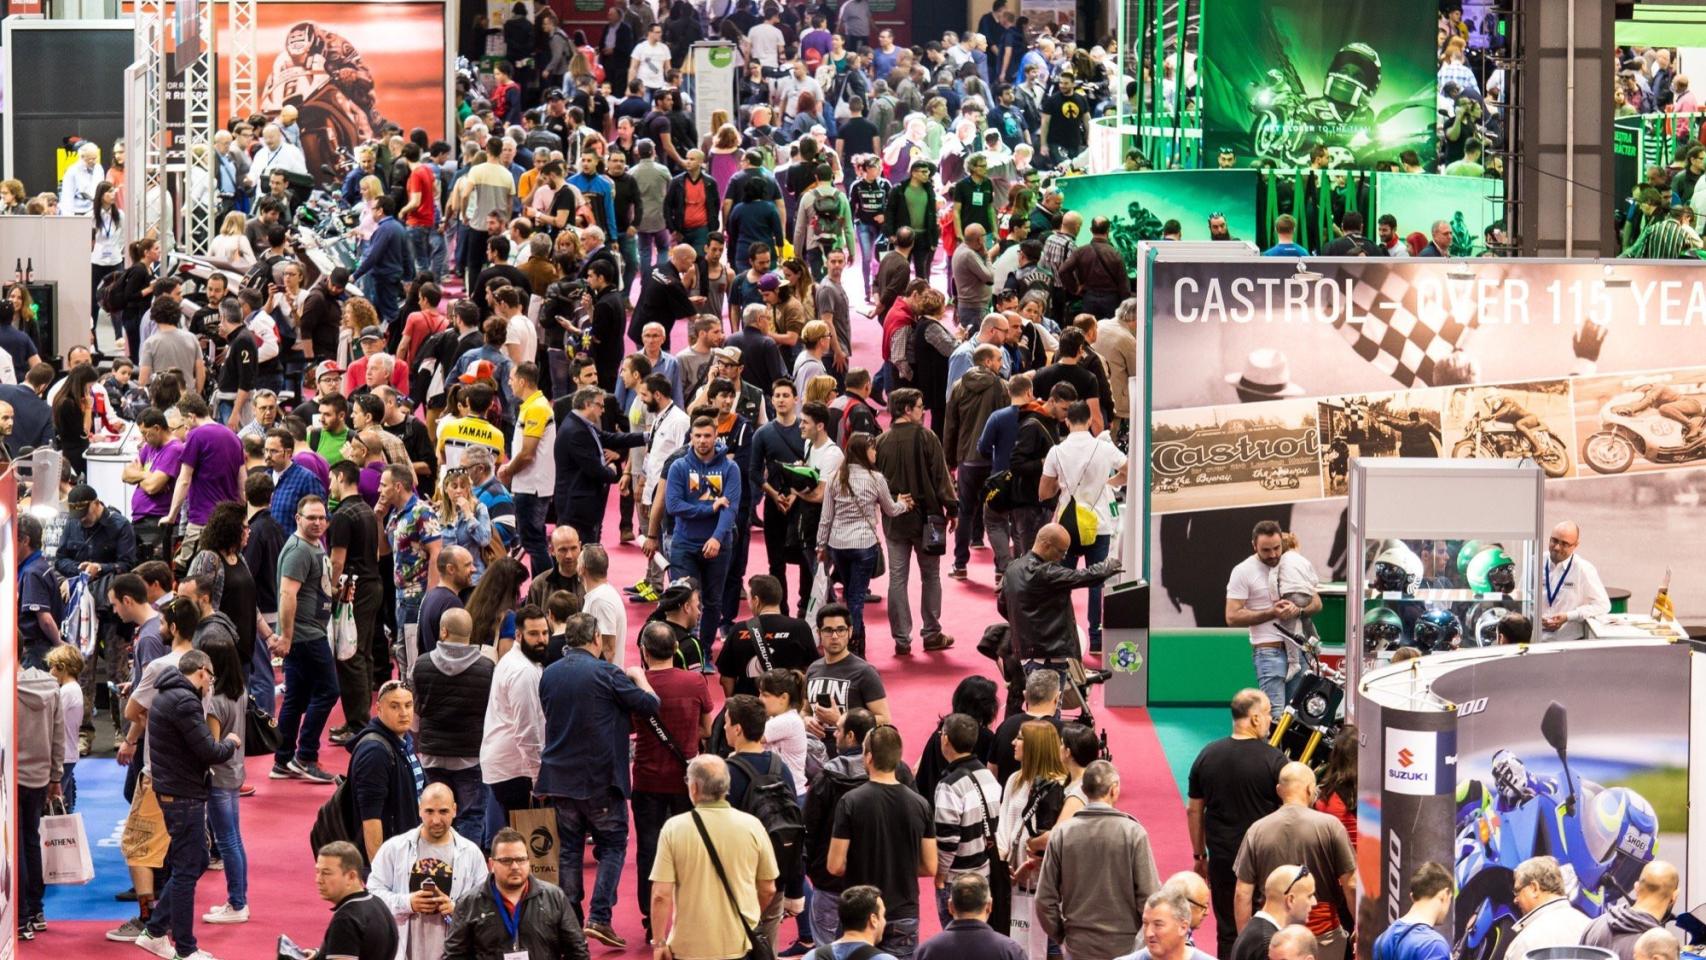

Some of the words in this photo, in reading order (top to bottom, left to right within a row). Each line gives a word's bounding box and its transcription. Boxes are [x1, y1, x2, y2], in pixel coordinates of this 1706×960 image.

[1174, 276, 1367, 323] CASTROL
[1416, 279, 1530, 325] OVER
[1546, 279, 1613, 325] 115
[241, 350, 250, 364] 2
[458, 425, 493, 440] YAMAHA
[1152, 428, 1319, 476] Castrol
[1388, 769, 1428, 781] SUZUKI
[49, 838, 76, 848] ATHENA
[530, 864, 556, 873] TOTAL
